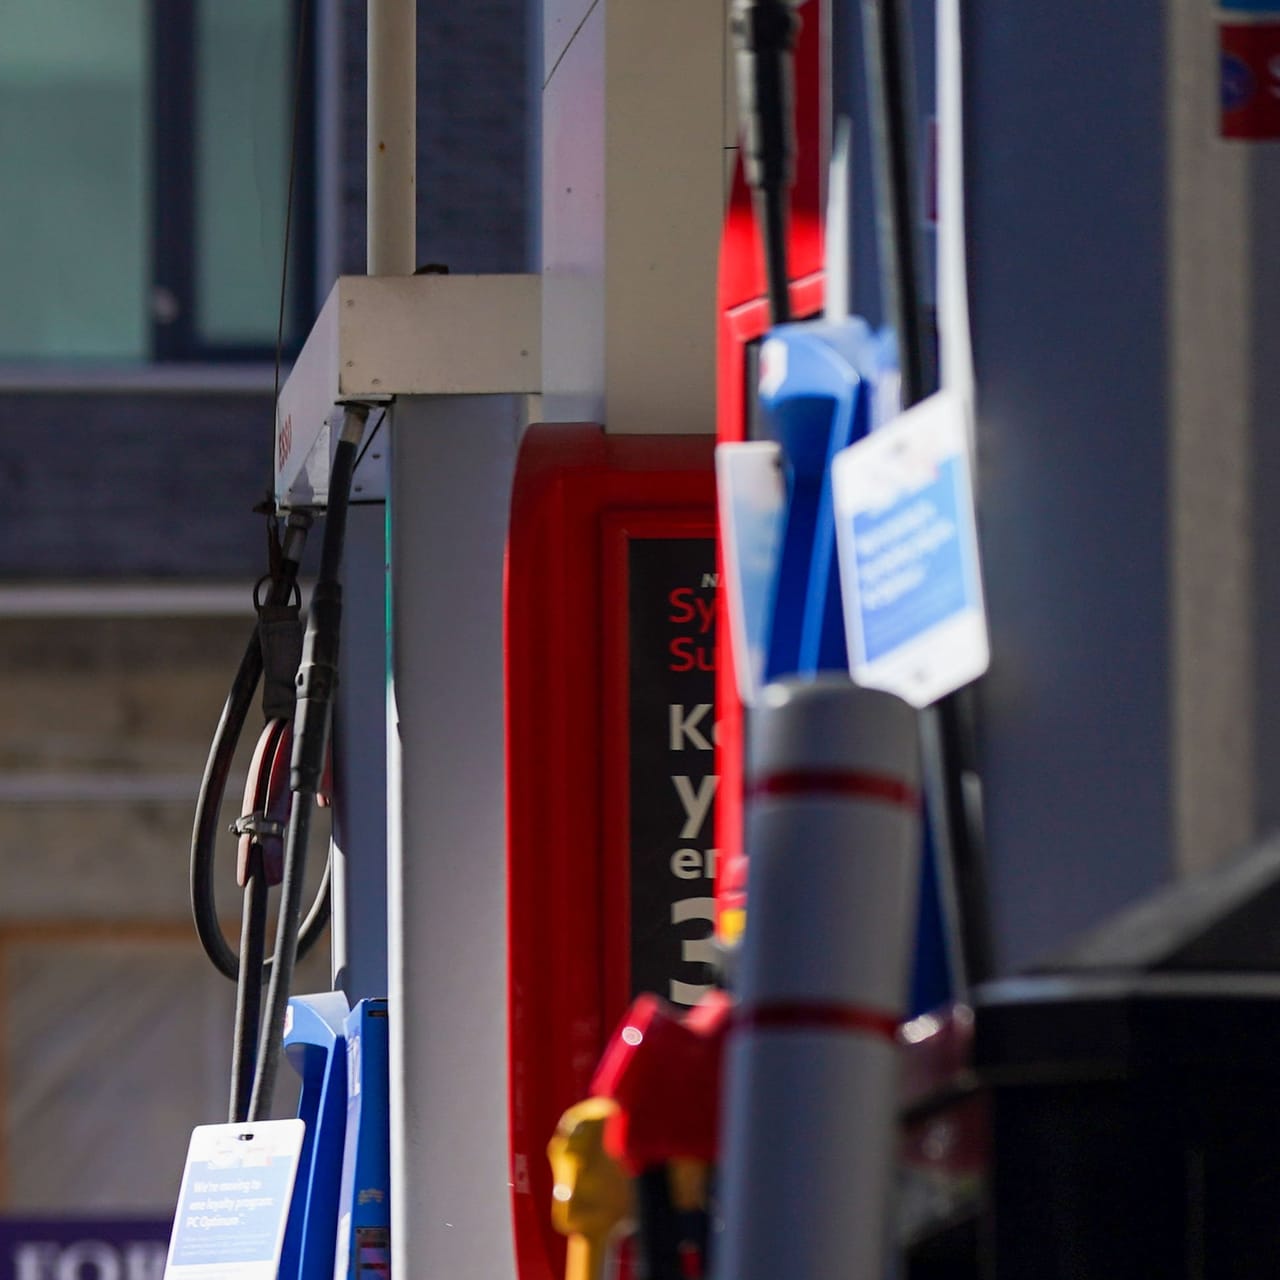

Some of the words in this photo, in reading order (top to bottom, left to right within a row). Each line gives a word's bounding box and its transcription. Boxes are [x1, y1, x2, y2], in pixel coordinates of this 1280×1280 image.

[669, 587, 716, 634] Sy
[669, 637, 716, 671] Su
[670, 774, 719, 839] y
